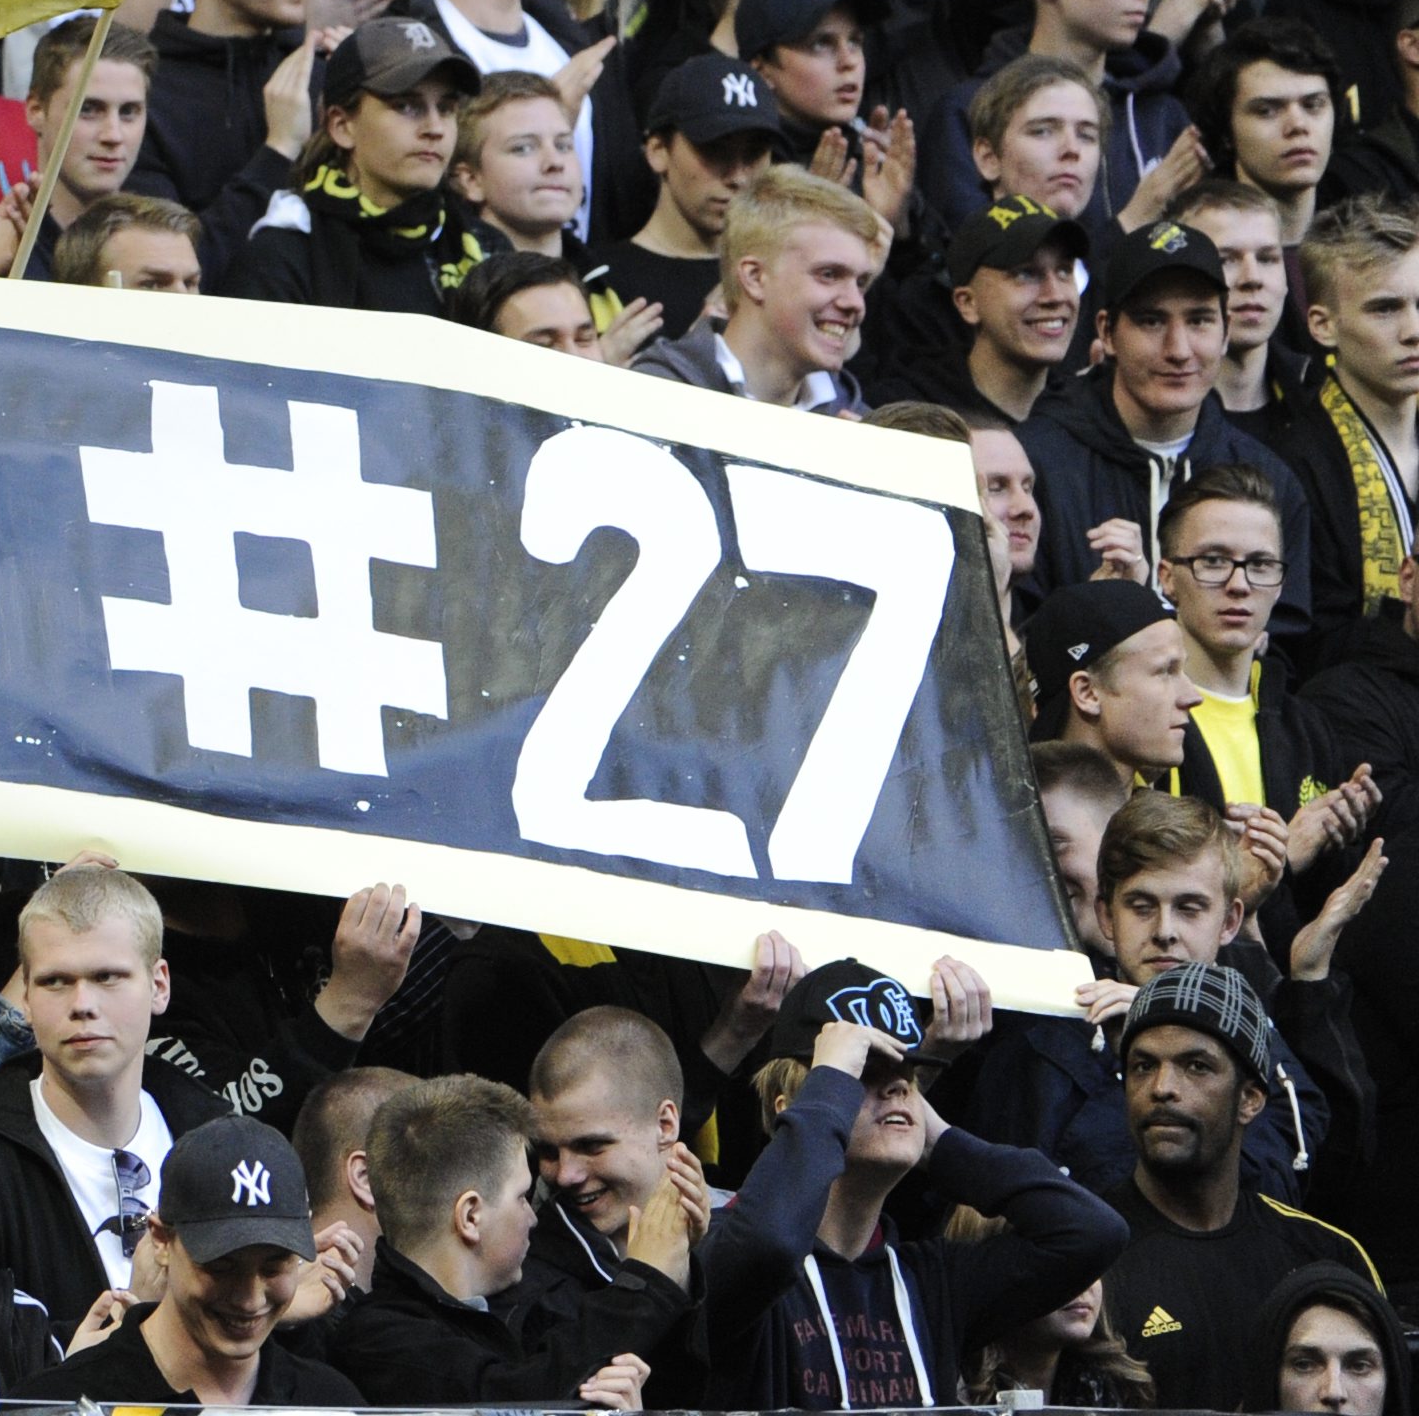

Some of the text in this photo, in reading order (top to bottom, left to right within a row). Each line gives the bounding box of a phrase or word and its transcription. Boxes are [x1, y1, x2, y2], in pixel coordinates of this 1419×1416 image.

[720, 71, 758, 108] NY
[228, 1159, 271, 1207] NY
[1141, 1320, 1183, 1338] adidas
